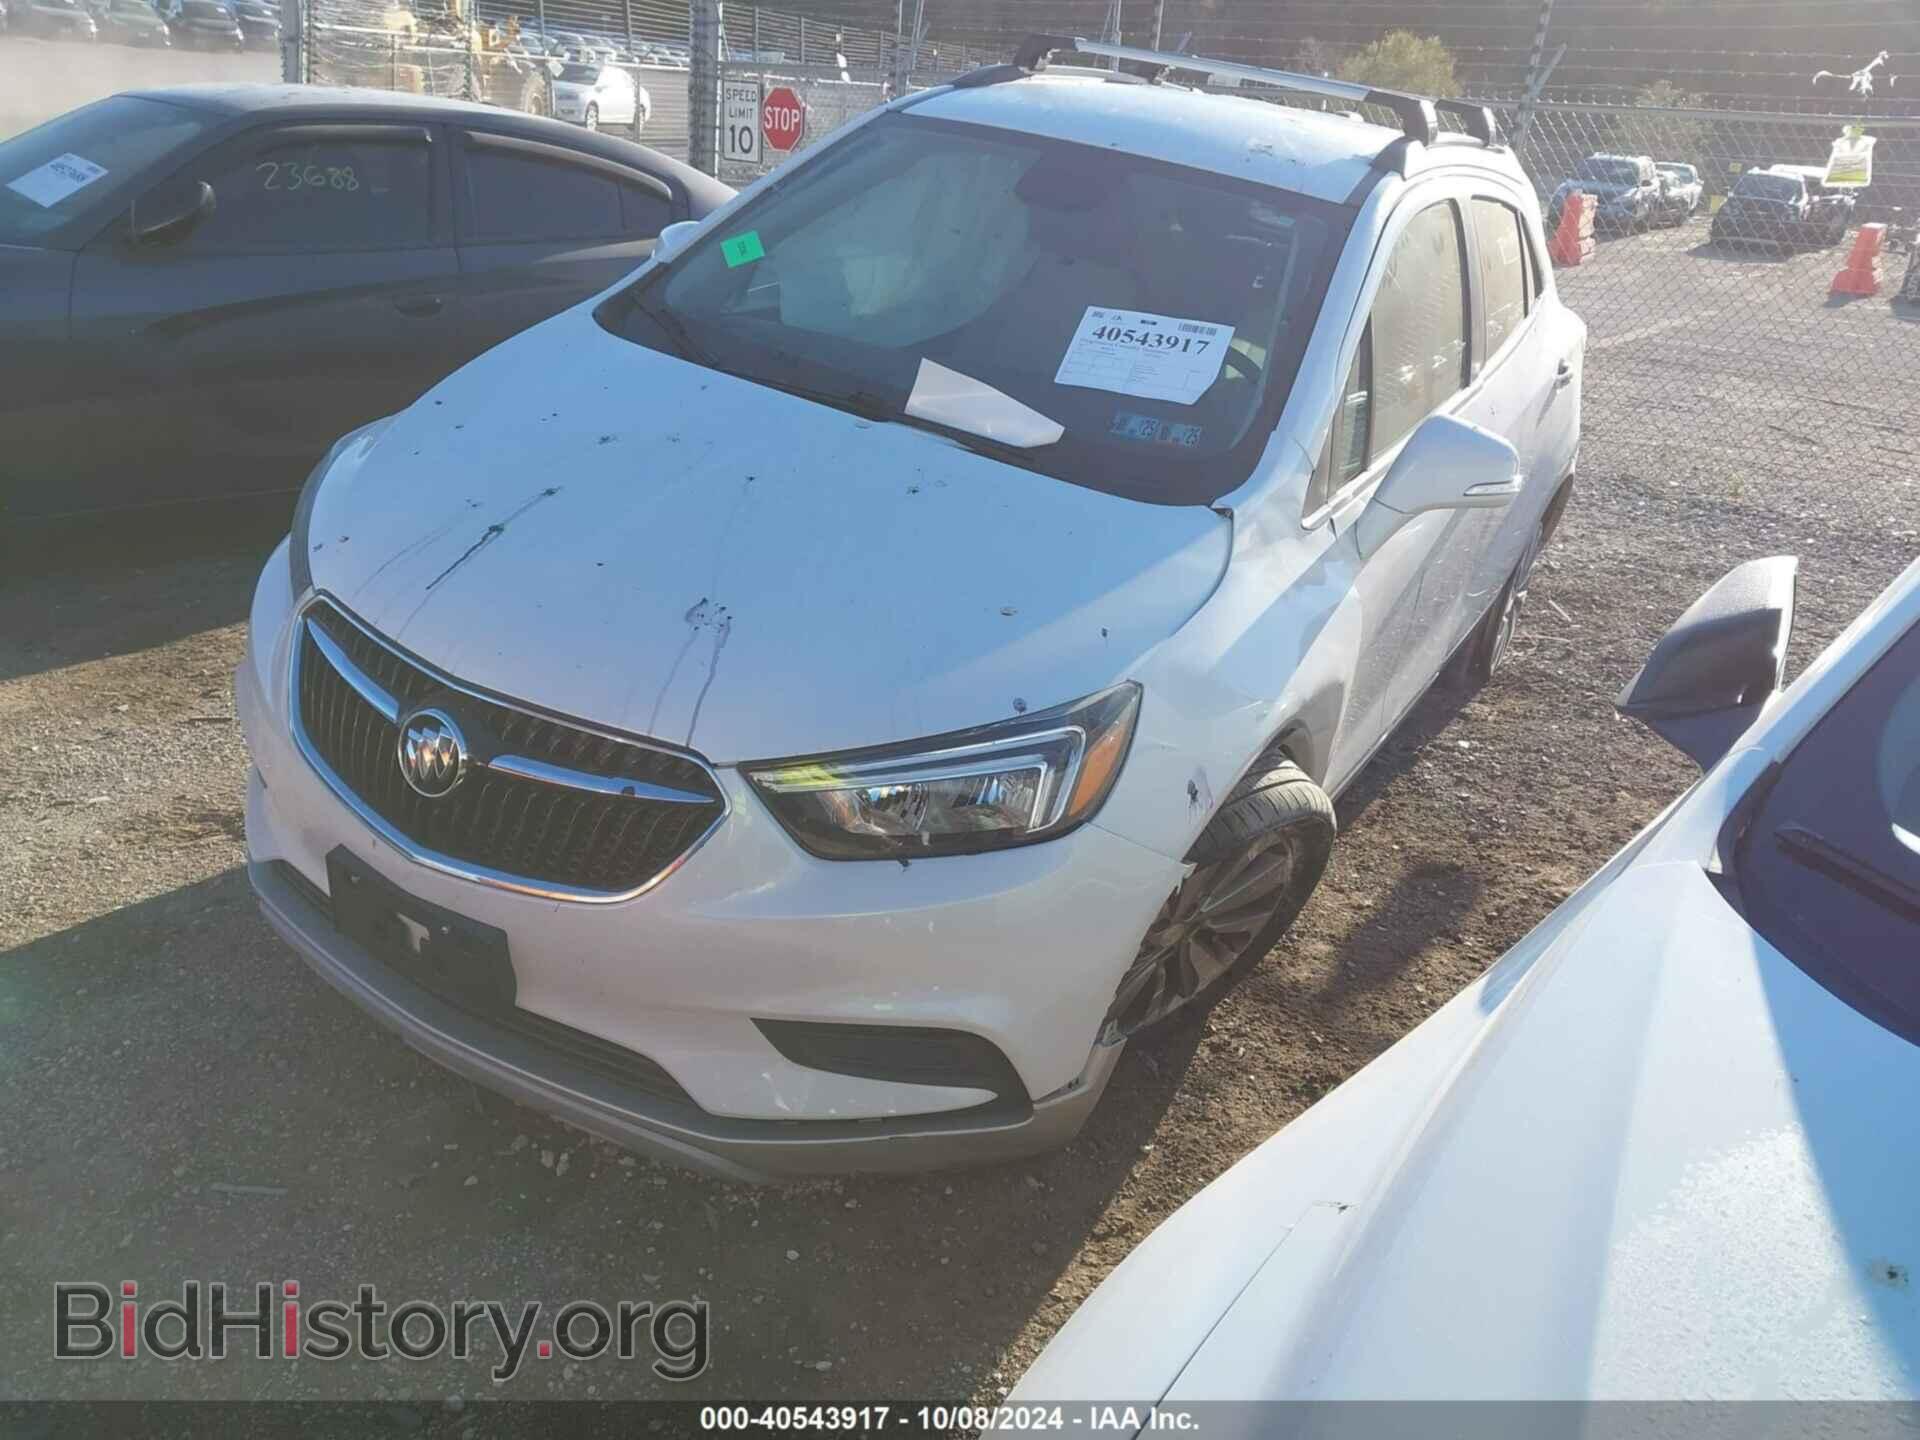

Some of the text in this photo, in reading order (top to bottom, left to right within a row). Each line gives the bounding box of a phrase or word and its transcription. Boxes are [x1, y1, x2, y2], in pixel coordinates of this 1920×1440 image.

[726, 88, 757, 102] SPEED
[729, 107, 753, 120] LIMIT
[764, 106, 800, 132] STOP
[729, 124, 753, 154] 10
[1092, 325, 1209, 354] 40543917
